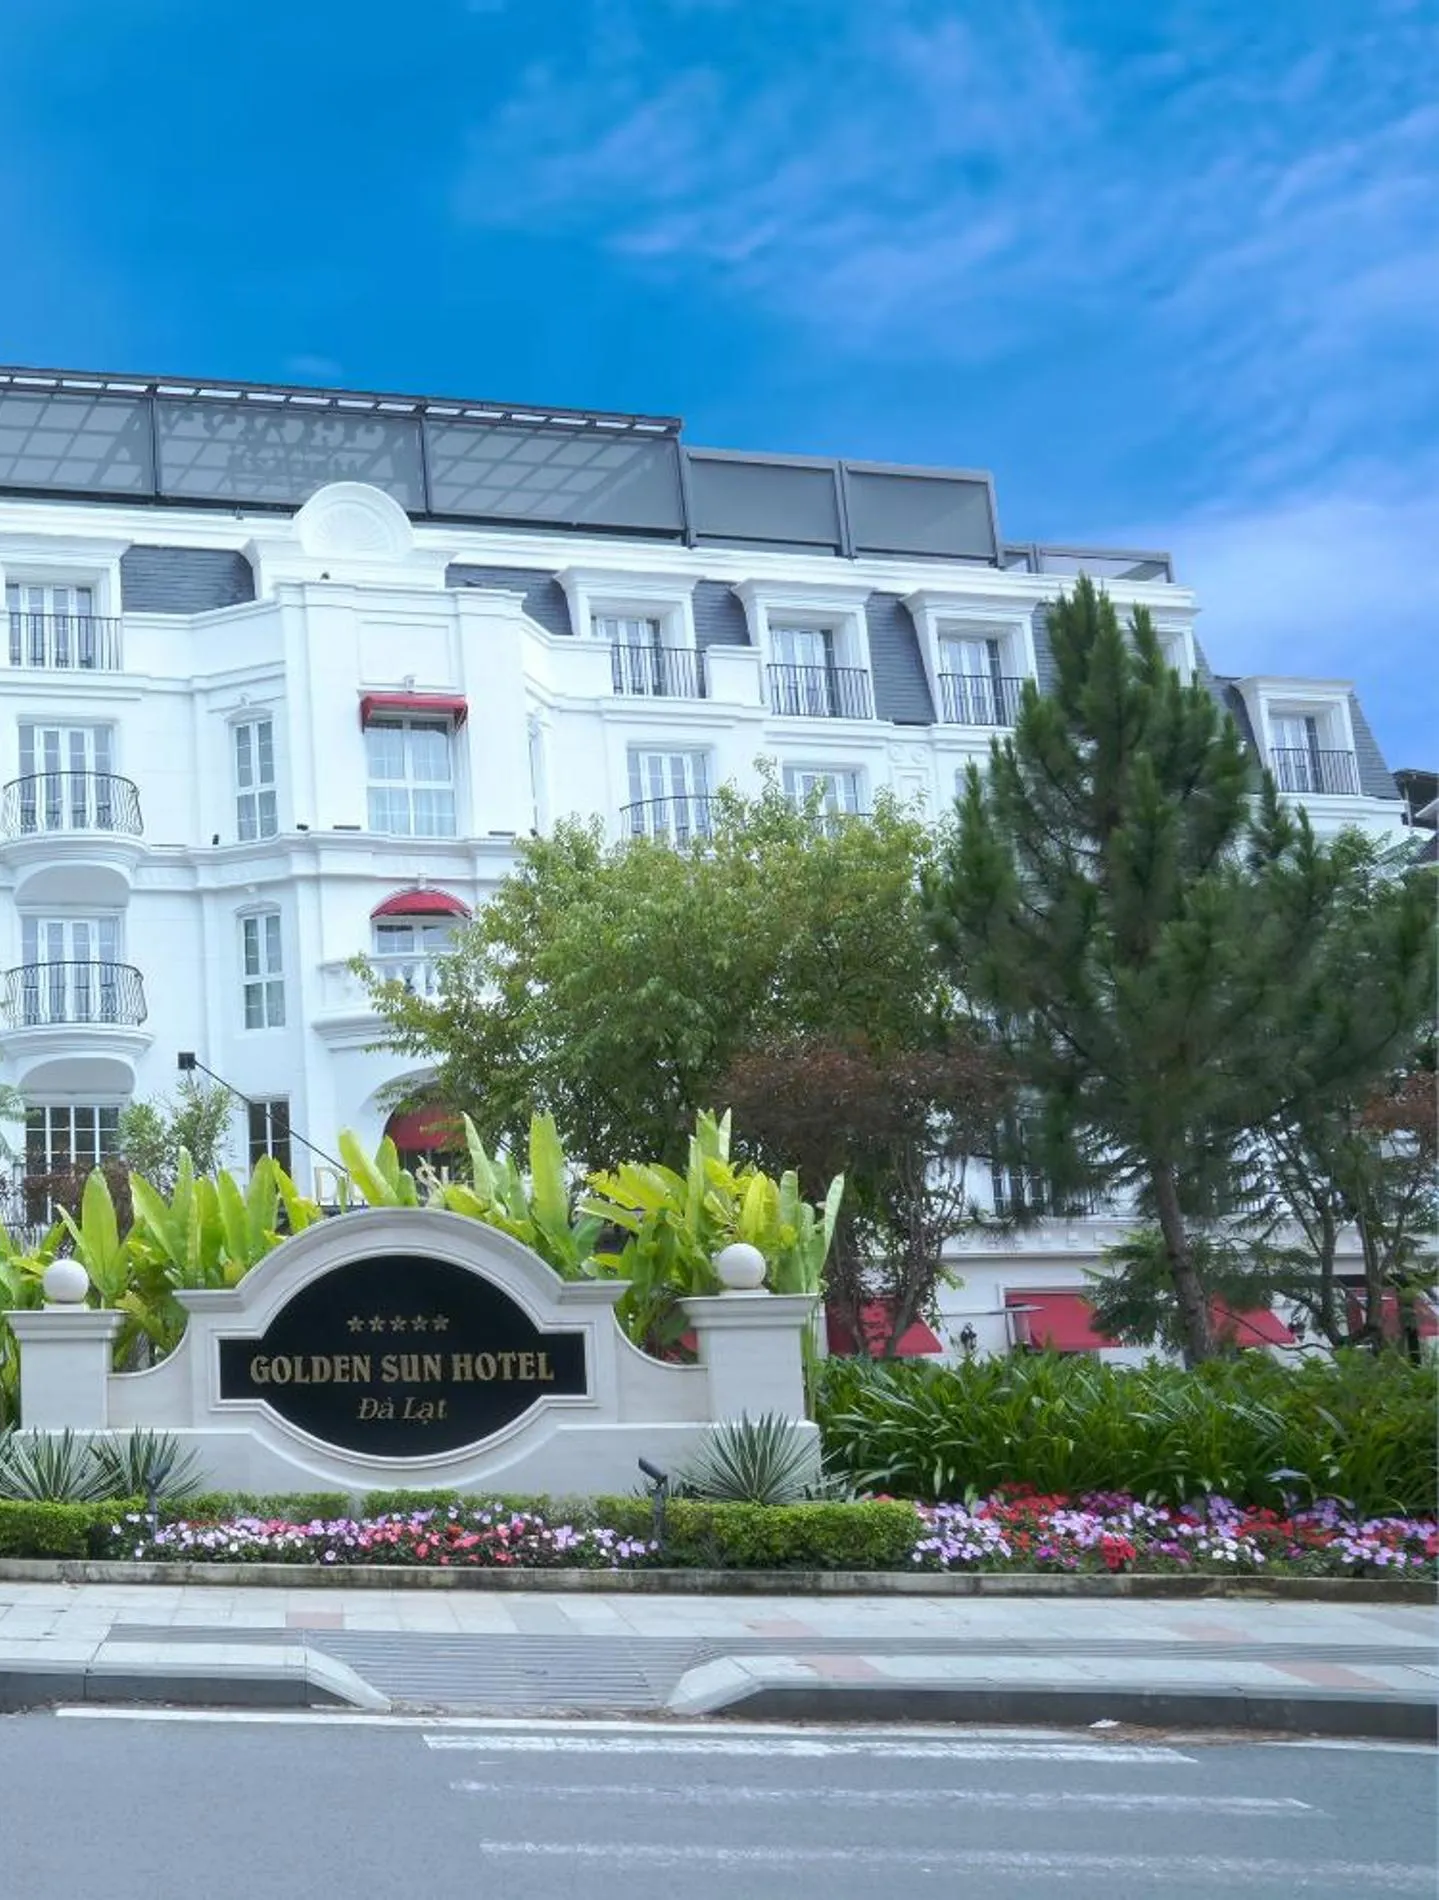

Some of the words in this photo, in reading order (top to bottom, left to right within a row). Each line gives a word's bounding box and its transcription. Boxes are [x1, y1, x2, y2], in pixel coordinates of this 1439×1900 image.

[250, 1354, 372, 1384] GOLDEN
[381, 1353, 442, 1382] SUN
[451, 1351, 554, 1381] HOTEL
[357, 1396, 394, 1420] Đà
[401, 1396, 448, 1424] Lạt
